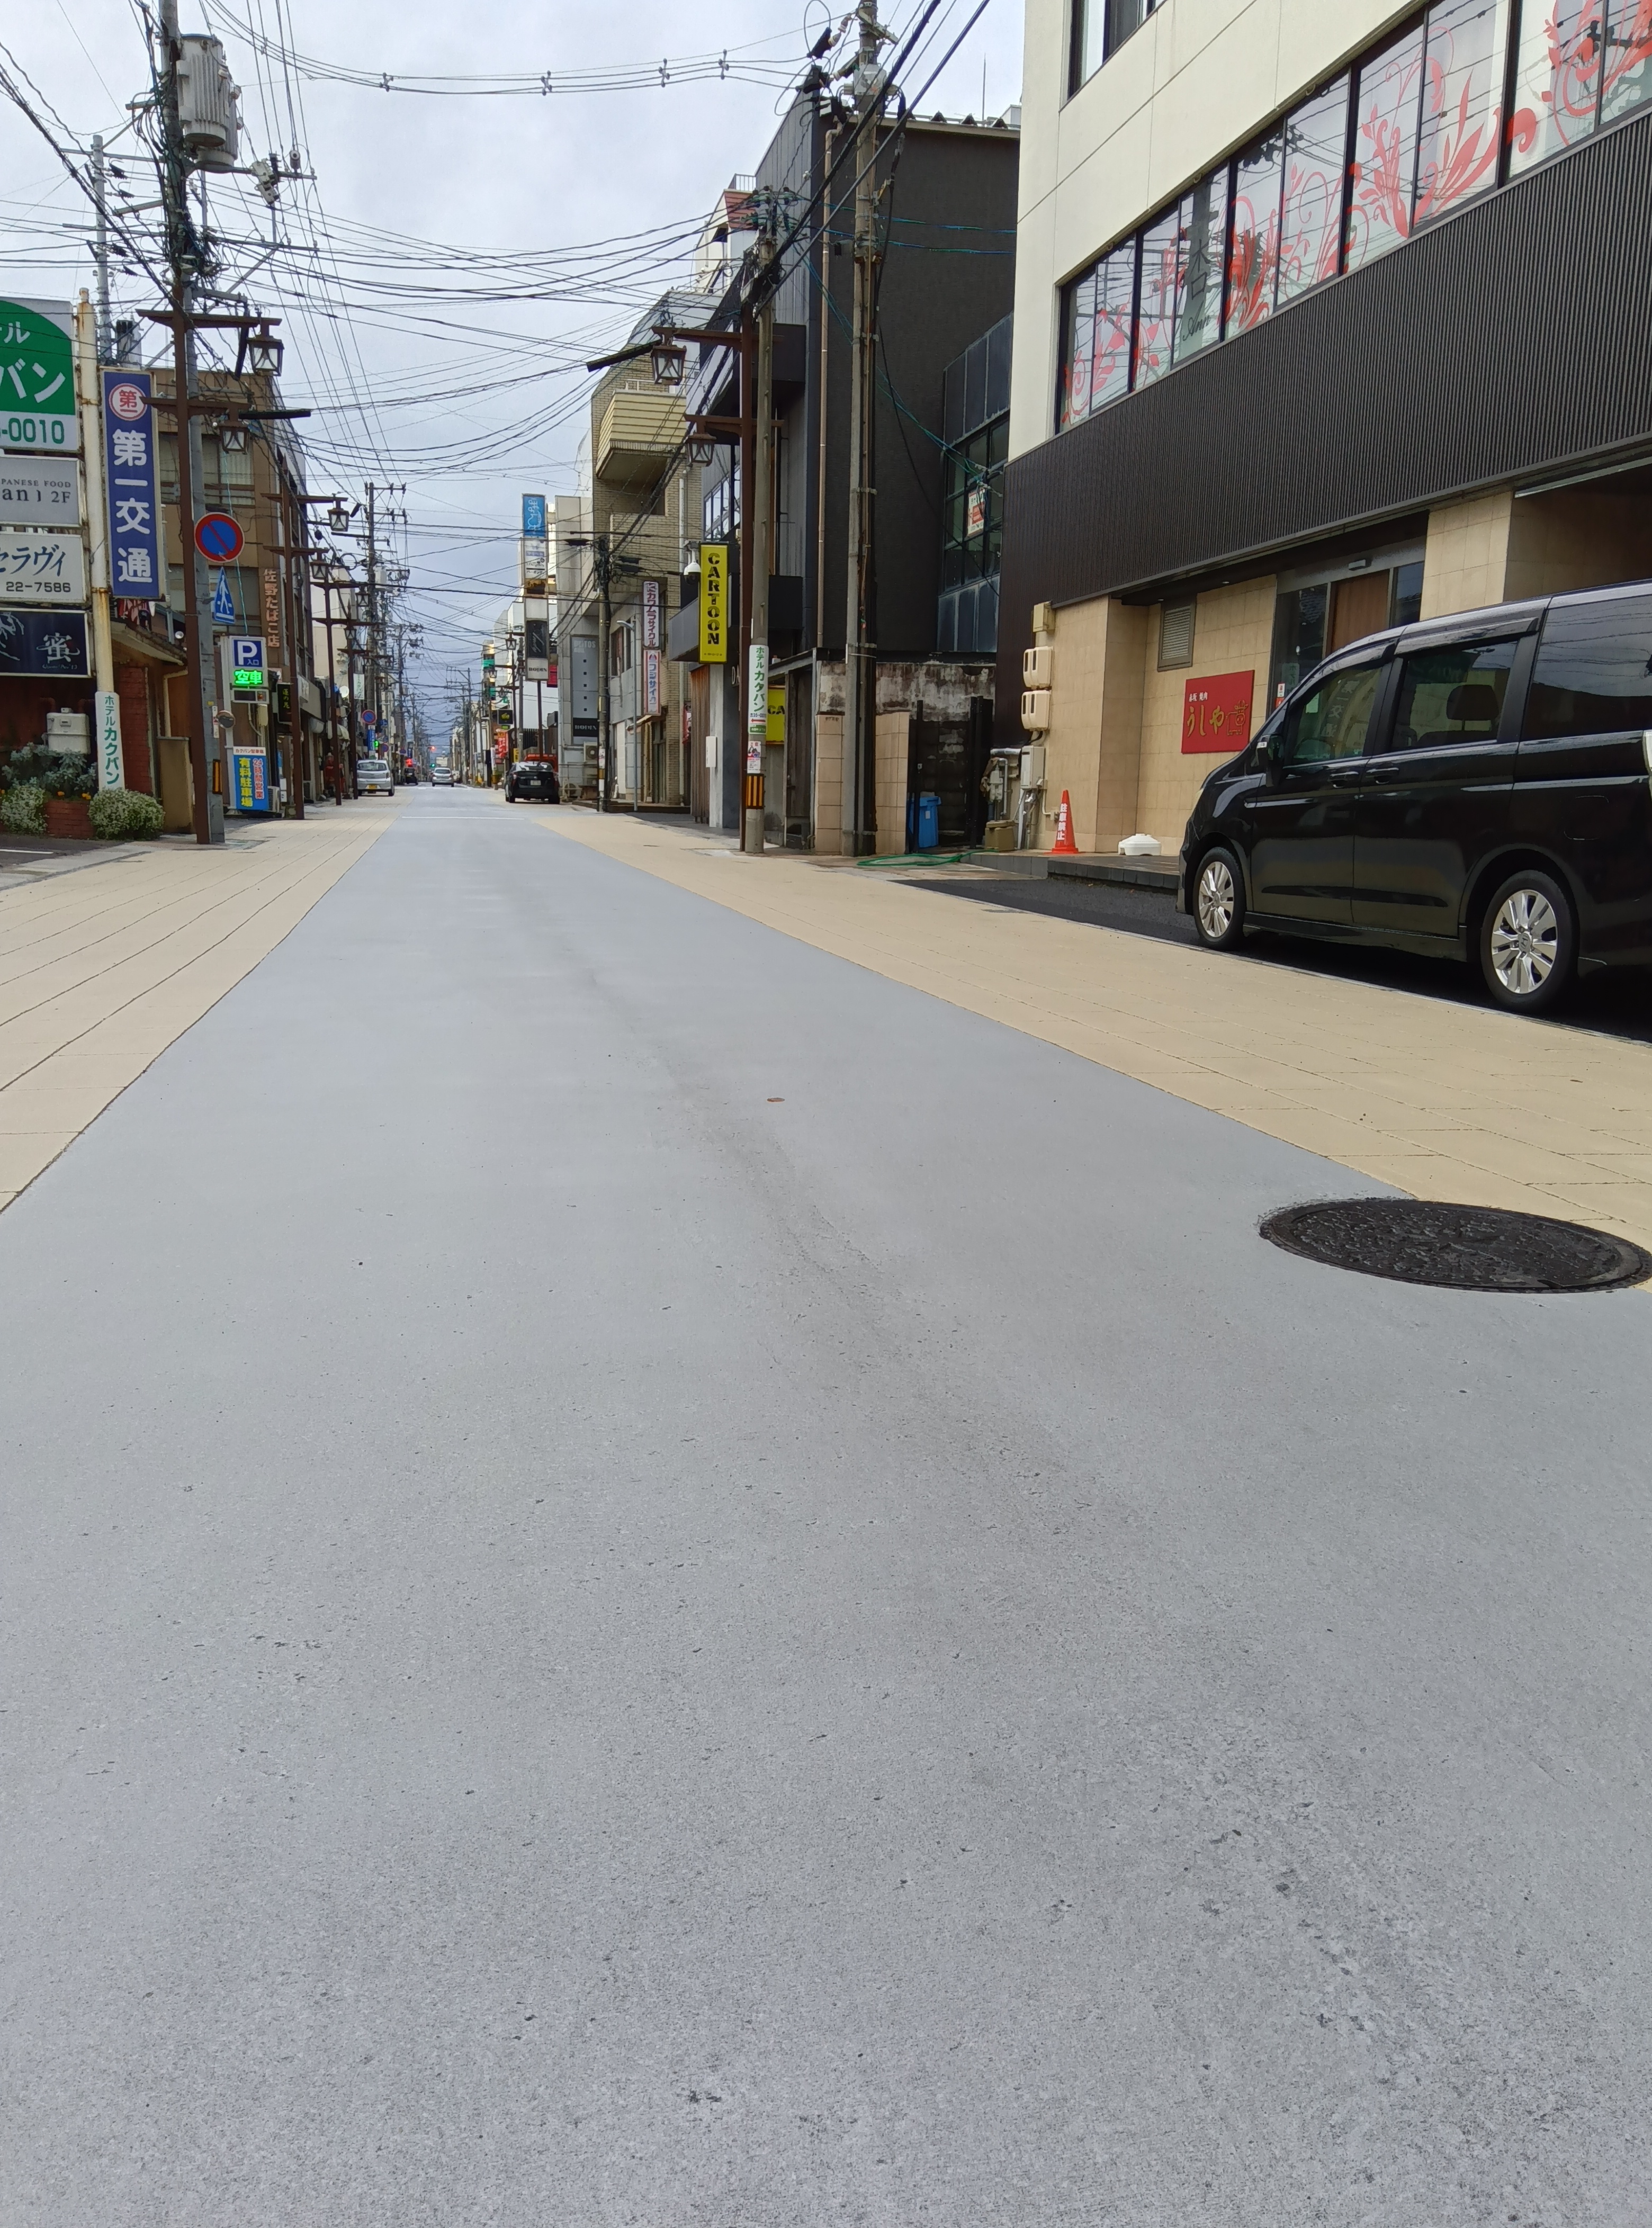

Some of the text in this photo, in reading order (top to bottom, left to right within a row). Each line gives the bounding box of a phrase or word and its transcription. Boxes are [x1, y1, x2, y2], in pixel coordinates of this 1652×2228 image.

[0, 321, 31, 344] ル
[0, 418, 65, 444] -0010
[112, 428, 153, 583] 第一交通
[6, 581, 71, 592] 22-7586
[707, 552, 721, 645] CARTOON
[264, 568, 280, 648] 佐野たばこ店
[235, 669, 263, 685] 空車
[1187, 704, 1225, 738] うしや
[239, 757, 254, 807] 有料駐車場
